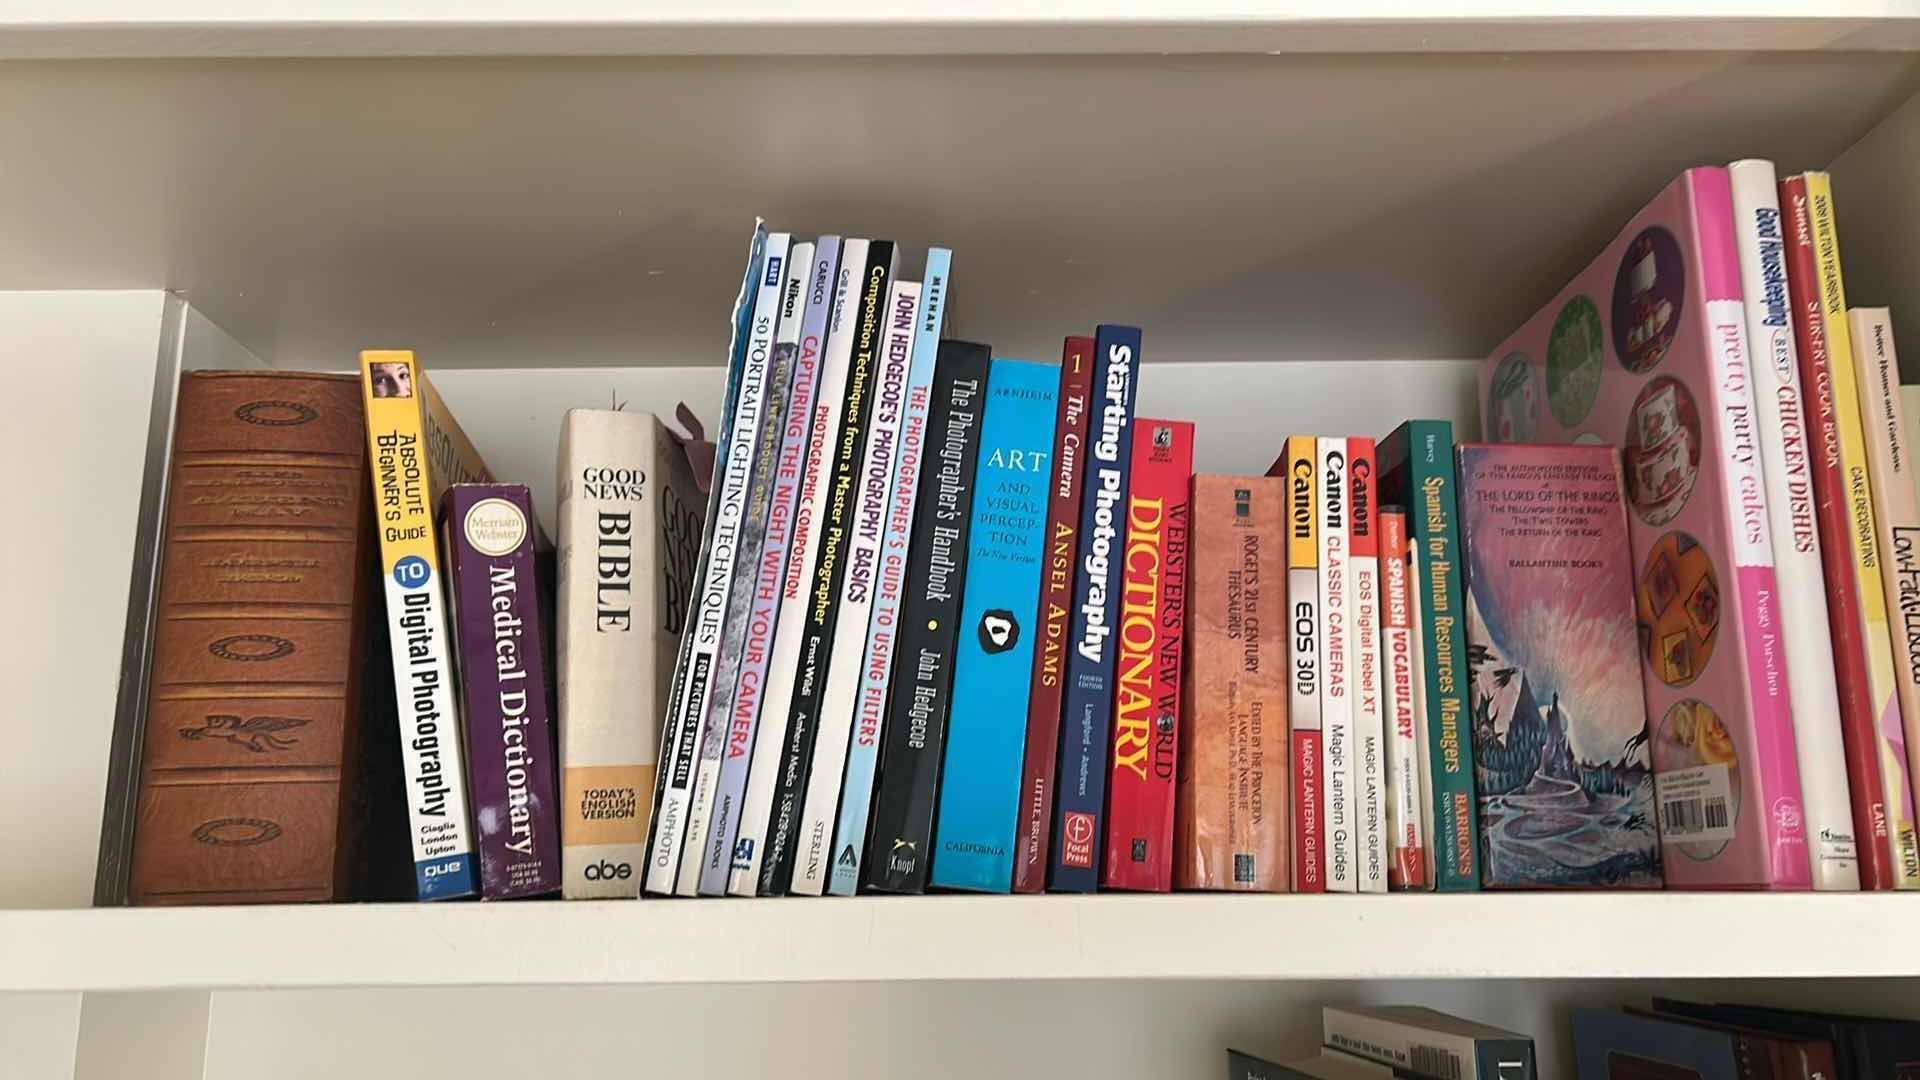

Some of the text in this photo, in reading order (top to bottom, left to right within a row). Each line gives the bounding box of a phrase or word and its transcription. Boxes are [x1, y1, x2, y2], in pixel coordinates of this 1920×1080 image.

[1793, 194, 1811, 247] Sunset
[783, 277, 801, 319] Nikon
[812, 260, 829, 305] CARUCCI
[860, 265, 886, 349] Composition
[925, 276, 942, 332] MEEHAN
[832, 298, 850, 333] Scanlon
[1807, 300, 1827, 367] SUNSET
[1072, 354, 1081, 374] 1
[1774, 337, 1790, 375] BEST
[847, 351, 872, 424] Techniques
[994, 387, 1052, 400] ARNHEIM
[844, 427, 860, 462] from
[847, 293, 916, 604] JOHN HEDGECOE'S PHOTOGRAPHY BASICS
[986, 447, 1048, 472] ART
[1058, 393, 1084, 498] The Camera
[1716, 322, 1764, 545] pretty party cakes
[377, 429, 401, 521] BEGINNER'S
[398, 433, 424, 516] ABSOLUTE
[583, 466, 647, 486] GOOD
[583, 484, 643, 502] NEWS
[700, 316, 770, 645] 50 PORTRAIT LIGHTING TECHNIQUES
[926, 379, 978, 602] The Photographer's Handbook
[997, 481, 1031, 496] AND
[1776, 384, 1815, 554] CHICKEN DISHES
[785, 405, 830, 600] PHOTOGRAPHIC COMPOSITION
[830, 475, 852, 525] Master
[986, 496, 1039, 514] VISUAL
[1077, 344, 1132, 664] Starting Photography
[1294, 457, 1313, 539] Canon
[1421, 476, 1447, 532] Spanish
[1849, 465, 1876, 569] CAKE DECORATING
[386, 526, 427, 543] GUIDE
[728, 335, 819, 759] CAPTURING THE NIGHT WITH YOUR CAMERA
[990, 530, 1028, 546] TION
[1244, 534, 1259, 585] ROGET'S
[1429, 536, 1448, 558] for
[397, 563, 425, 582] TO
[596, 511, 633, 634] BIBLE
[814, 527, 843, 626] Photographer
[858, 385, 928, 747] THE PHOTOGRAPHER'S GUIDE TO USING FILTERS
[1162, 502, 1188, 631] WEBSTER'S
[1326, 450, 1344, 698] Canon CLASSIC CAMERAS
[1351, 457, 1376, 715] Canon EOS Digital Rebel XT
[1387, 556, 1406, 625] SPANISH
[1431, 559, 1452, 612] Human
[489, 564, 528, 682] Medical
[1041, 522, 1075, 688] ANSEL ADAMS
[1227, 570, 1242, 640] THESAURUS
[1757, 590, 1770, 628] Peggy
[801, 636, 821, 696] Ernst Wildi
[1113, 494, 1164, 782] DICTIONARY
[1160, 635, 1180, 684] NEW
[1244, 617, 1260, 675] CENTURY
[1295, 602, 1315, 696] EOS 30D
[1434, 615, 1456, 694] Resources
[697, 658, 710, 679] FOR
[1391, 631, 1413, 740] VOCABULARY
[400, 592, 451, 818] Digital Photography
[686, 679, 706, 730] PICTURES
[908, 648, 941, 749] John Hedgecoe
[682, 730, 697, 756] THAT
[1439, 697, 1462, 774] Managers
[499, 690, 534, 856] Dictionary
[583, 788, 635, 801] TODAY'S
[675, 757, 690, 782] SELL
[785, 755, 800, 788] Media
[420, 822, 456, 835] Ciaglia
[580, 799, 636, 811] ENGLISH
[580, 809, 635, 821] VERSION
[716, 794, 732, 837] AMPHOTO
[1302, 738, 1317, 884] MAGIC LANTERN GUIDES
[1329, 723, 1347, 881] Magic Lantern Guides
[1364, 736, 1380, 881] MAGIC LANTERN GUIDES
[1871, 802, 1888, 838] LANE
[420, 833, 459, 846] London
[424, 843, 457, 856] Upton
[656, 799, 679, 868] AMPHOTO
[805, 819, 825, 881] STERLING
[945, 841, 1006, 857] CALIFORNIA
[1066, 842, 1089, 854] Focal
[1066, 852, 1089, 864] Press
[1455, 793, 1472, 876] BARRON'S
[1899, 829, 1918, 878] WILTON
[889, 855, 916, 876] Knopf
